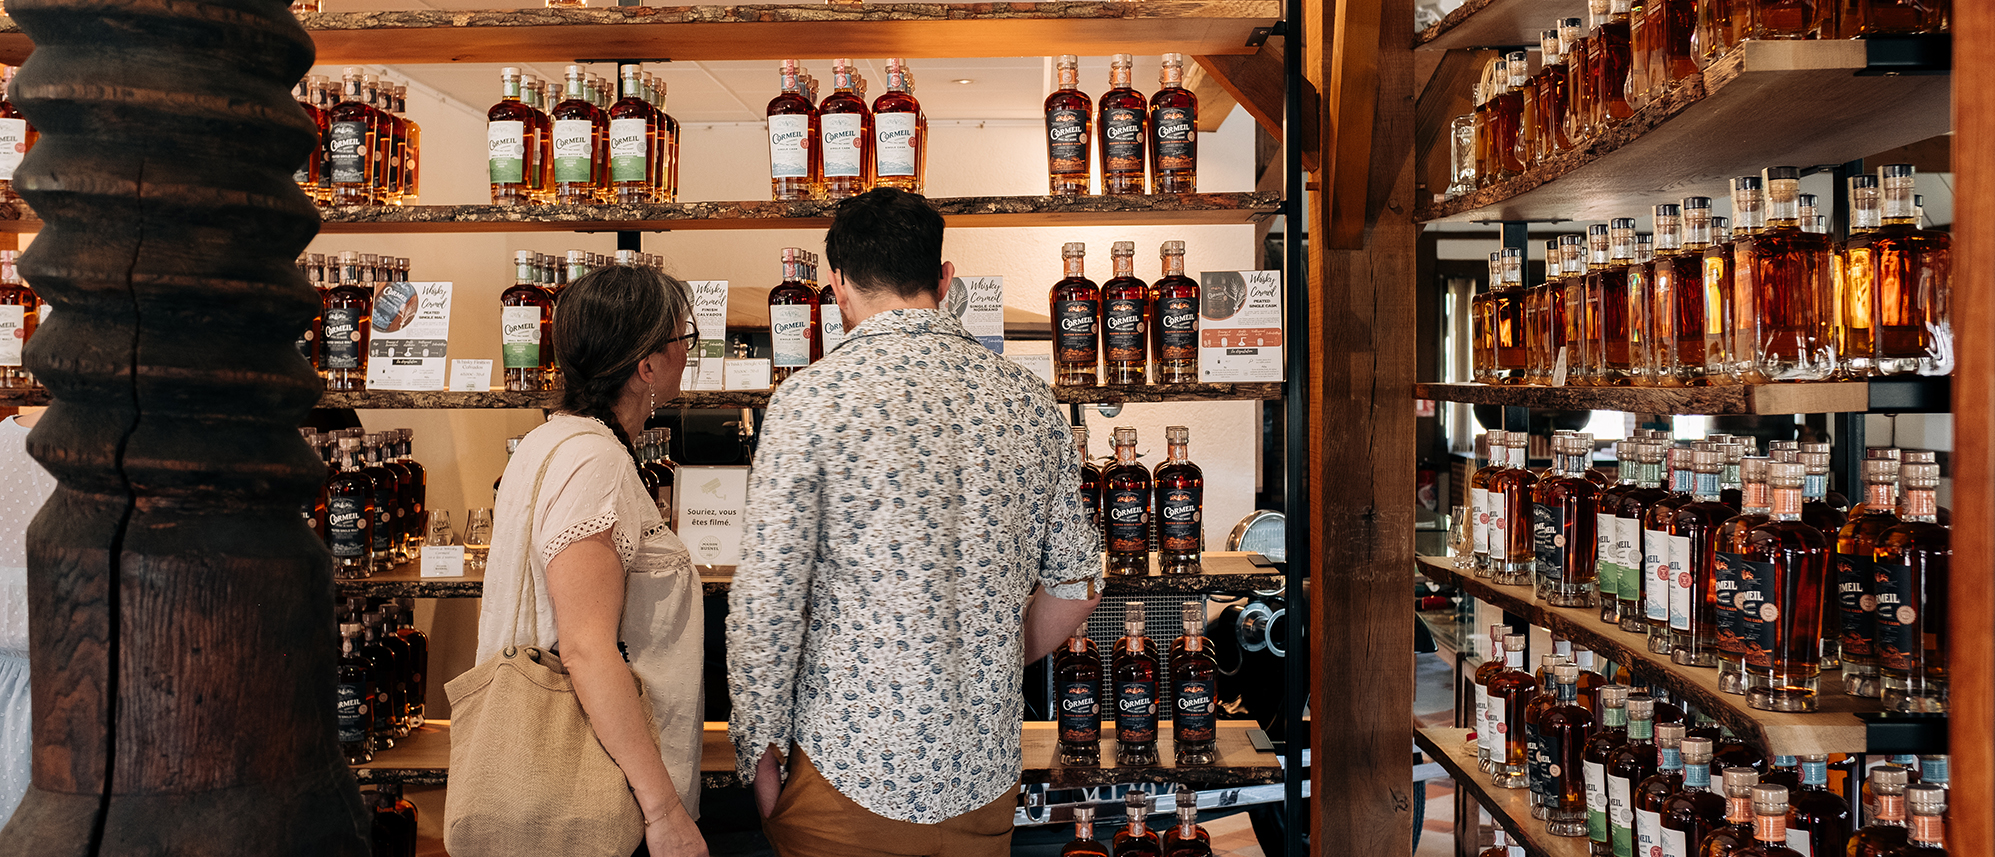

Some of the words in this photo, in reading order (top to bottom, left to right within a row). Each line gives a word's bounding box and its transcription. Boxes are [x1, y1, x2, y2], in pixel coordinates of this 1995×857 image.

[825, 130, 855, 143] CORMEIL
[879, 129, 910, 142] CORMEIL
[1050, 126, 1082, 140] CORMEIL
[1107, 125, 1138, 139] CORMEIL
[1157, 124, 1189, 138] CORMEIL
[489, 137, 517, 150] CORMEIL
[555, 137, 586, 149] CORMEIL
[611, 135, 639, 149] CORMEIL
[772, 132, 803, 144] CORMEIL
[331, 138, 360, 152] CORMEIL
[1249, 270, 1275, 287] Whisky
[422, 283, 447, 299] Whisky
[696, 281, 725, 297] Whisky
[970, 277, 1000, 294] Whisky
[1250, 286, 1278, 297] Cormeil
[695, 295, 726, 306] Cormeil
[970, 291, 1002, 303] Cormeil
[421, 299, 447, 309] Cormeil
[774, 321, 805, 334] CORMEIL
[1061, 317, 1093, 330] CORMEIL
[1107, 315, 1139, 329] CORMEIL
[1163, 314, 1194, 328] CORMEIL
[325, 325, 354, 338] CORMEIL
[504, 323, 535, 335] CORMEIL
[687, 508, 717, 516] Souriez,
[1111, 507, 1143, 520] CORMEIL
[1163, 506, 1195, 518] CORMEIL
[330, 512, 360, 526] CORMEIL
[691, 518, 708, 526] êtes
[1063, 698, 1094, 711] CORMEIL
[1119, 698, 1151, 711] CORMEIL
[1178, 697, 1209, 710] CORMEIL
